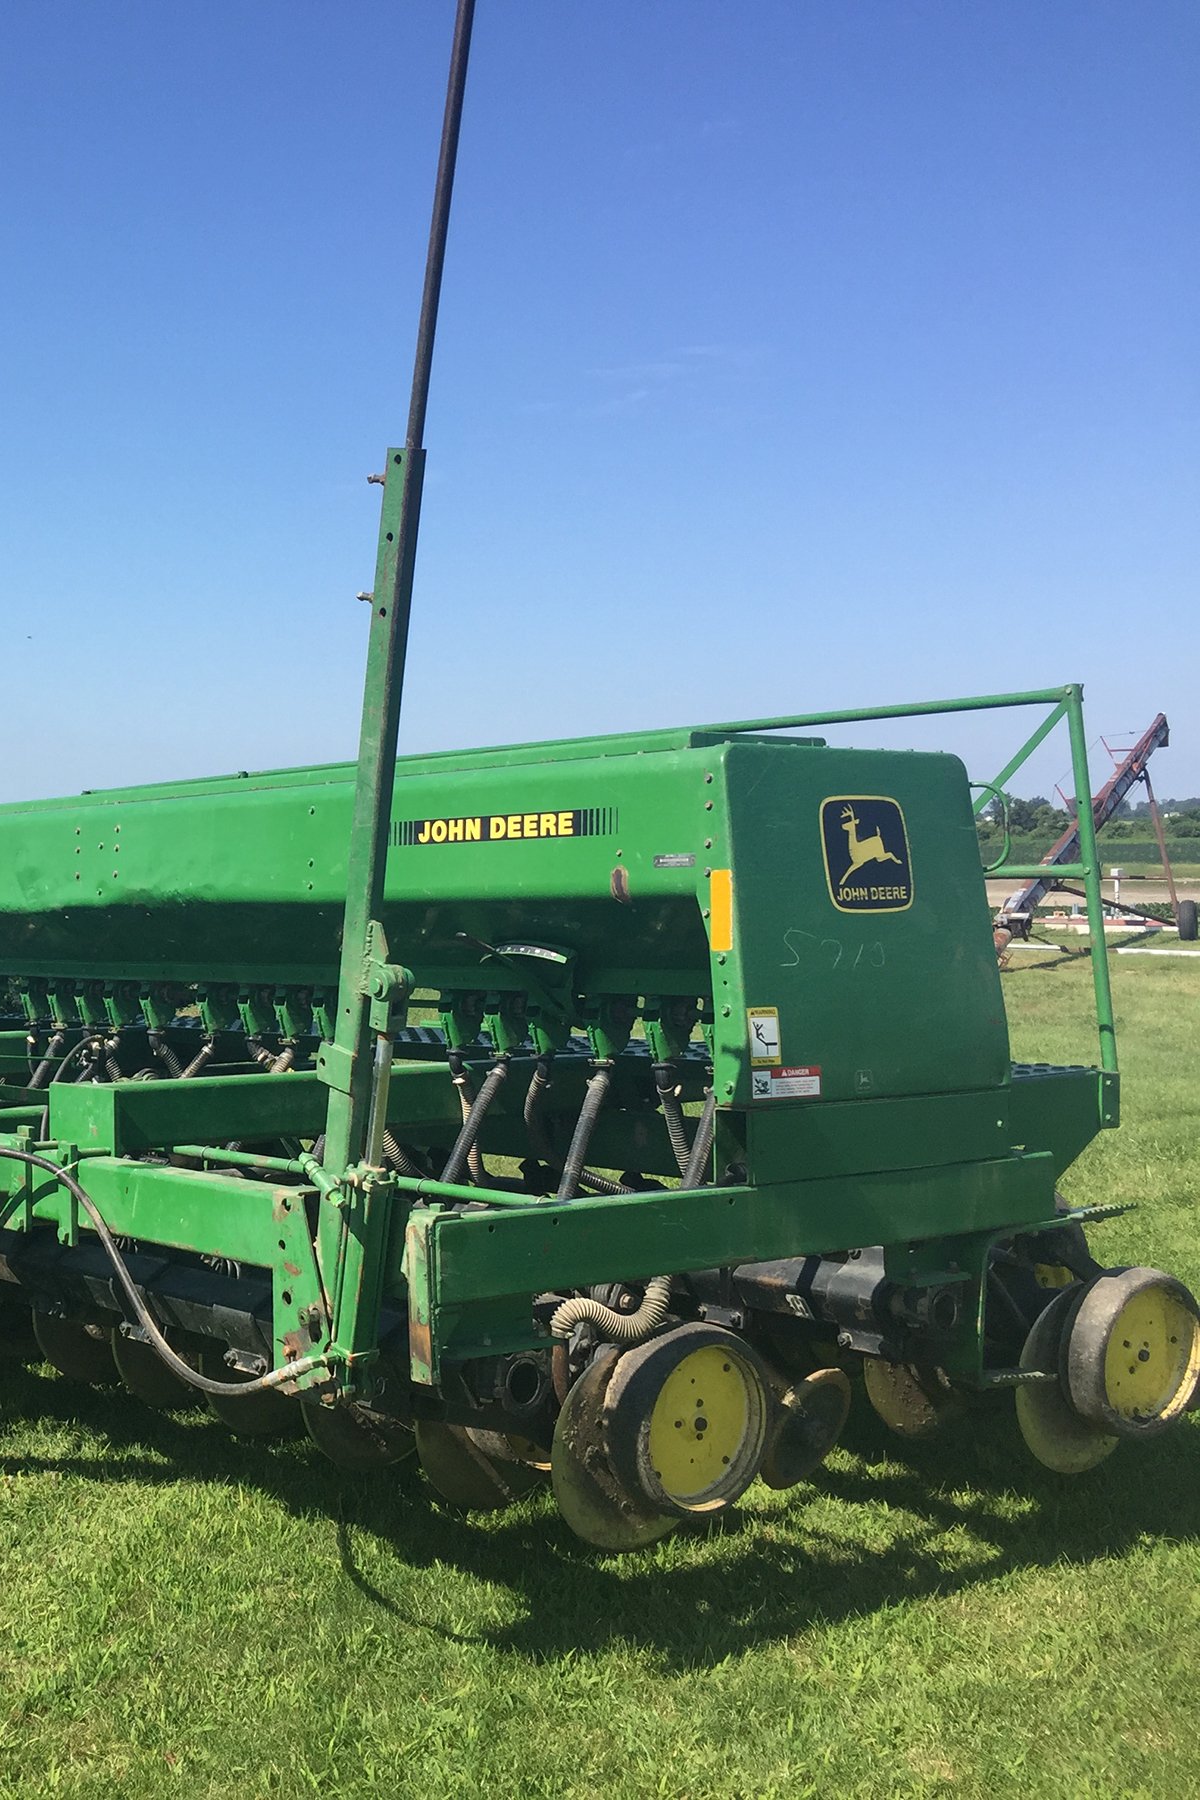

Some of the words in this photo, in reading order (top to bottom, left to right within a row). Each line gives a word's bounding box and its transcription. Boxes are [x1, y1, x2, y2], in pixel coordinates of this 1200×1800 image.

[417, 817, 482, 844] JOHN
[489, 811, 574, 840] DEERE
[837, 887, 869, 902] JOHN
[870, 886, 908, 901] DEERE
[786, 1068, 810, 1077] DANGER
